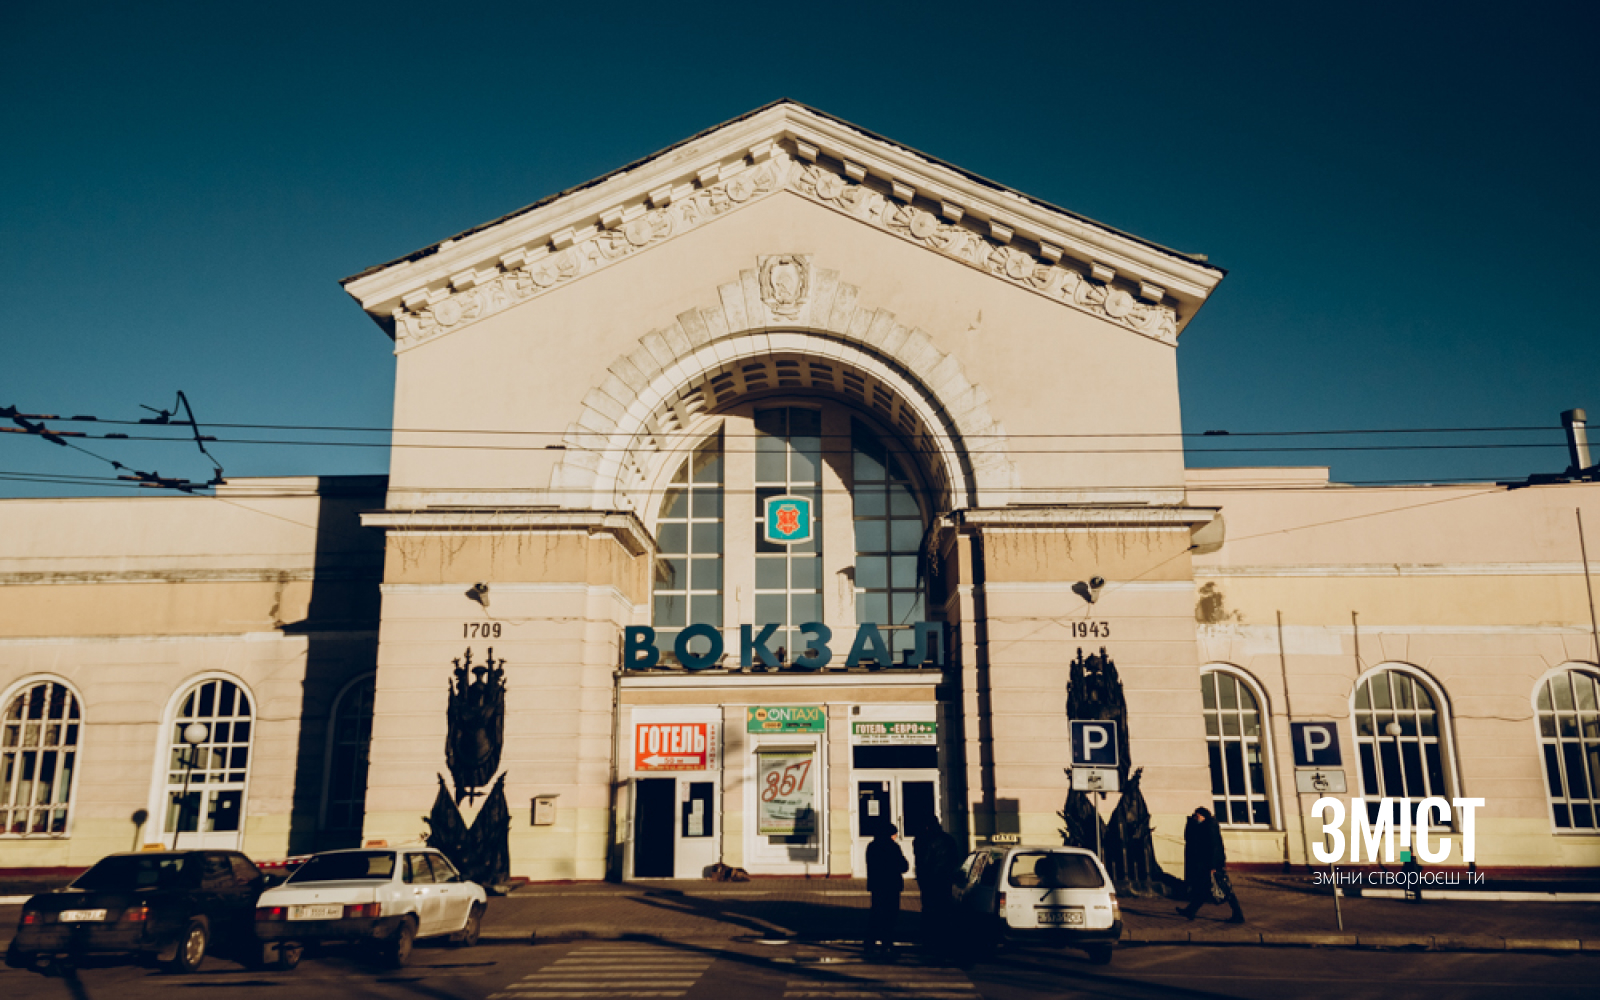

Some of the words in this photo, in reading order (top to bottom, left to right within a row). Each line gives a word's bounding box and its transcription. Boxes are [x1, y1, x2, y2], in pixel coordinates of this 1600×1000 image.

[463, 623, 501, 638] 1709
[1072, 621, 1110, 638] 1943
[623, 622, 946, 671] ВОКЗАЛ
[639, 725, 705, 754] ГОТЕЛЬ
[855, 724, 887, 734] ГОТЕЛЬ
[1083, 725, 1108, 760] P
[1304, 726, 1331, 762] P
